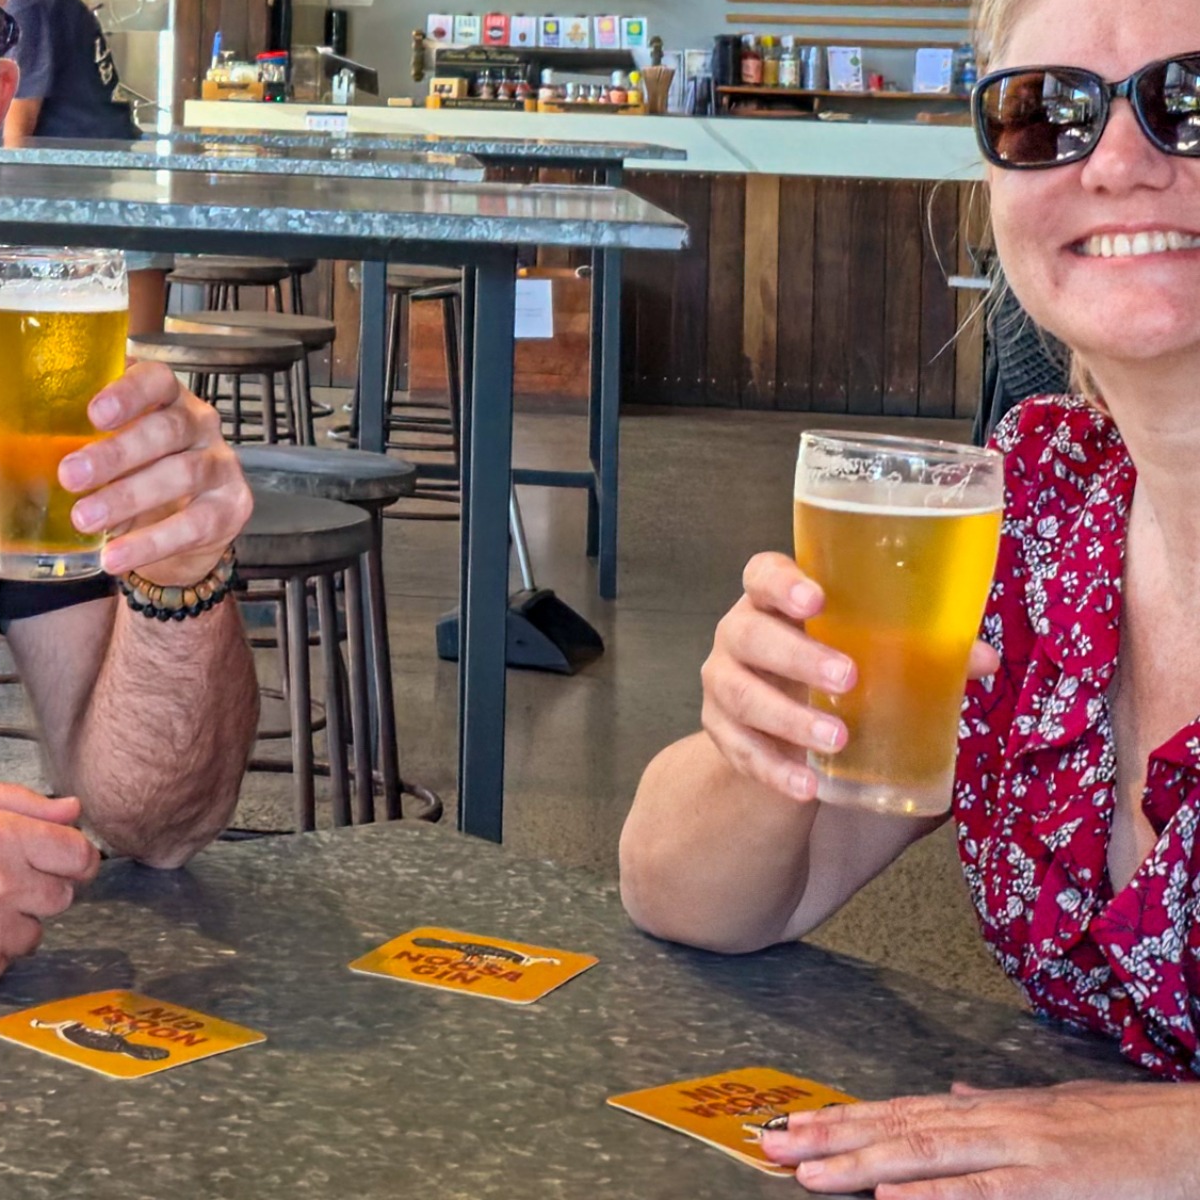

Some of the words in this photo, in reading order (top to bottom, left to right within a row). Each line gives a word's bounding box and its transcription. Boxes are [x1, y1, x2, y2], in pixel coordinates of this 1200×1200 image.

[392, 950, 524, 983] NOOSA
[410, 964, 482, 985] GIN
[88, 1004, 209, 1047] NOOSA
[140, 1006, 205, 1030] GIN
[678, 1085, 813, 1119] NOOSA
[679, 1081, 756, 1102] GIN
